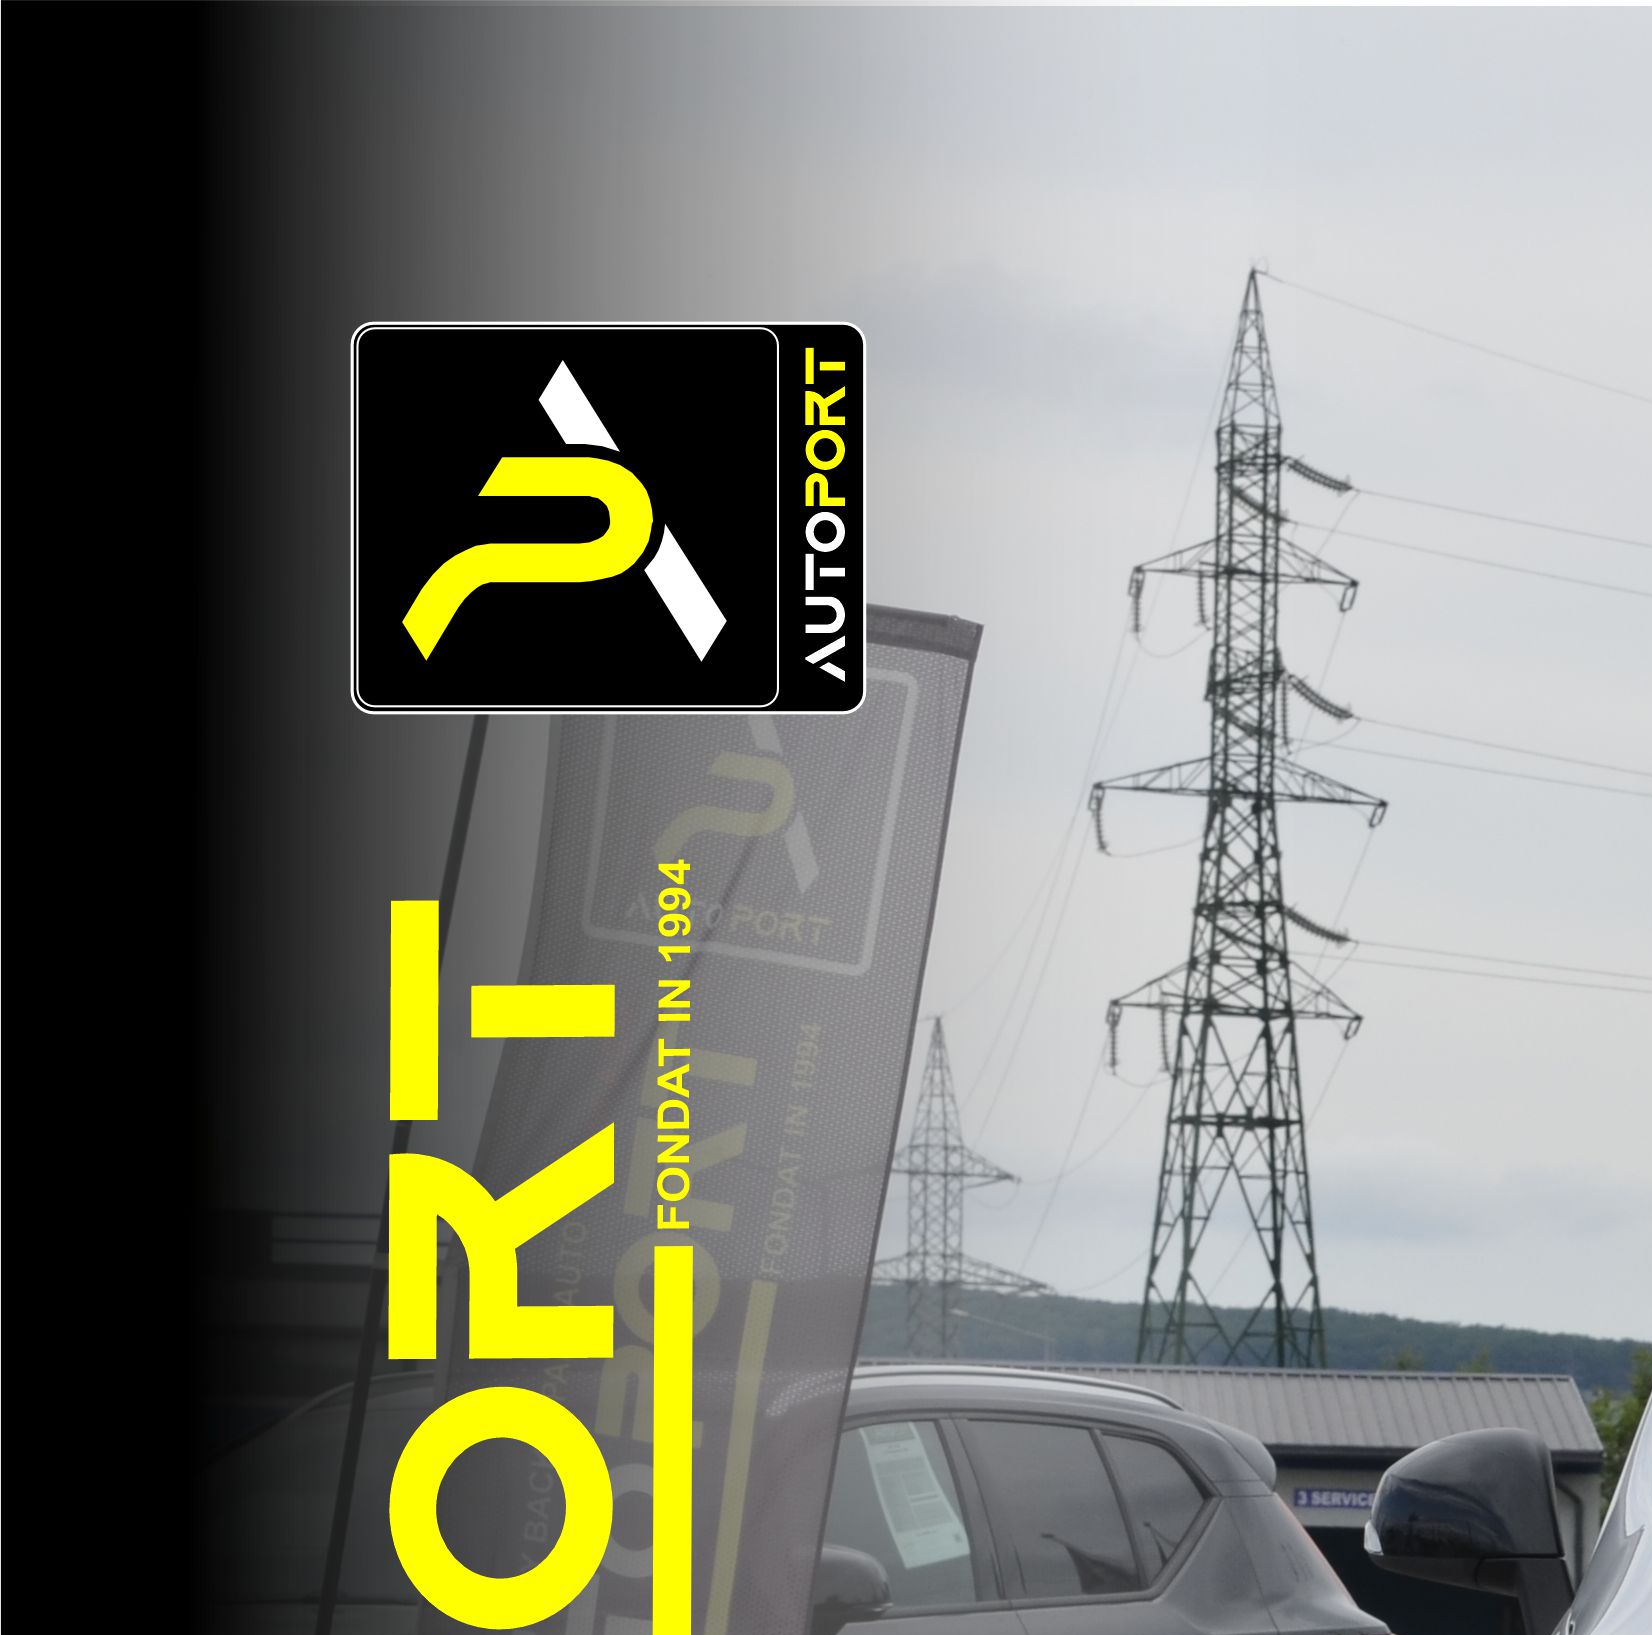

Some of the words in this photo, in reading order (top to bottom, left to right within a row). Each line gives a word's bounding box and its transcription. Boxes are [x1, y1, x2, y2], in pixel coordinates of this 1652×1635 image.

[793, 1022, 821, 1091] 1994
[785, 1105, 811, 1137] IN
[759, 1147, 806, 1280] FONDAT
